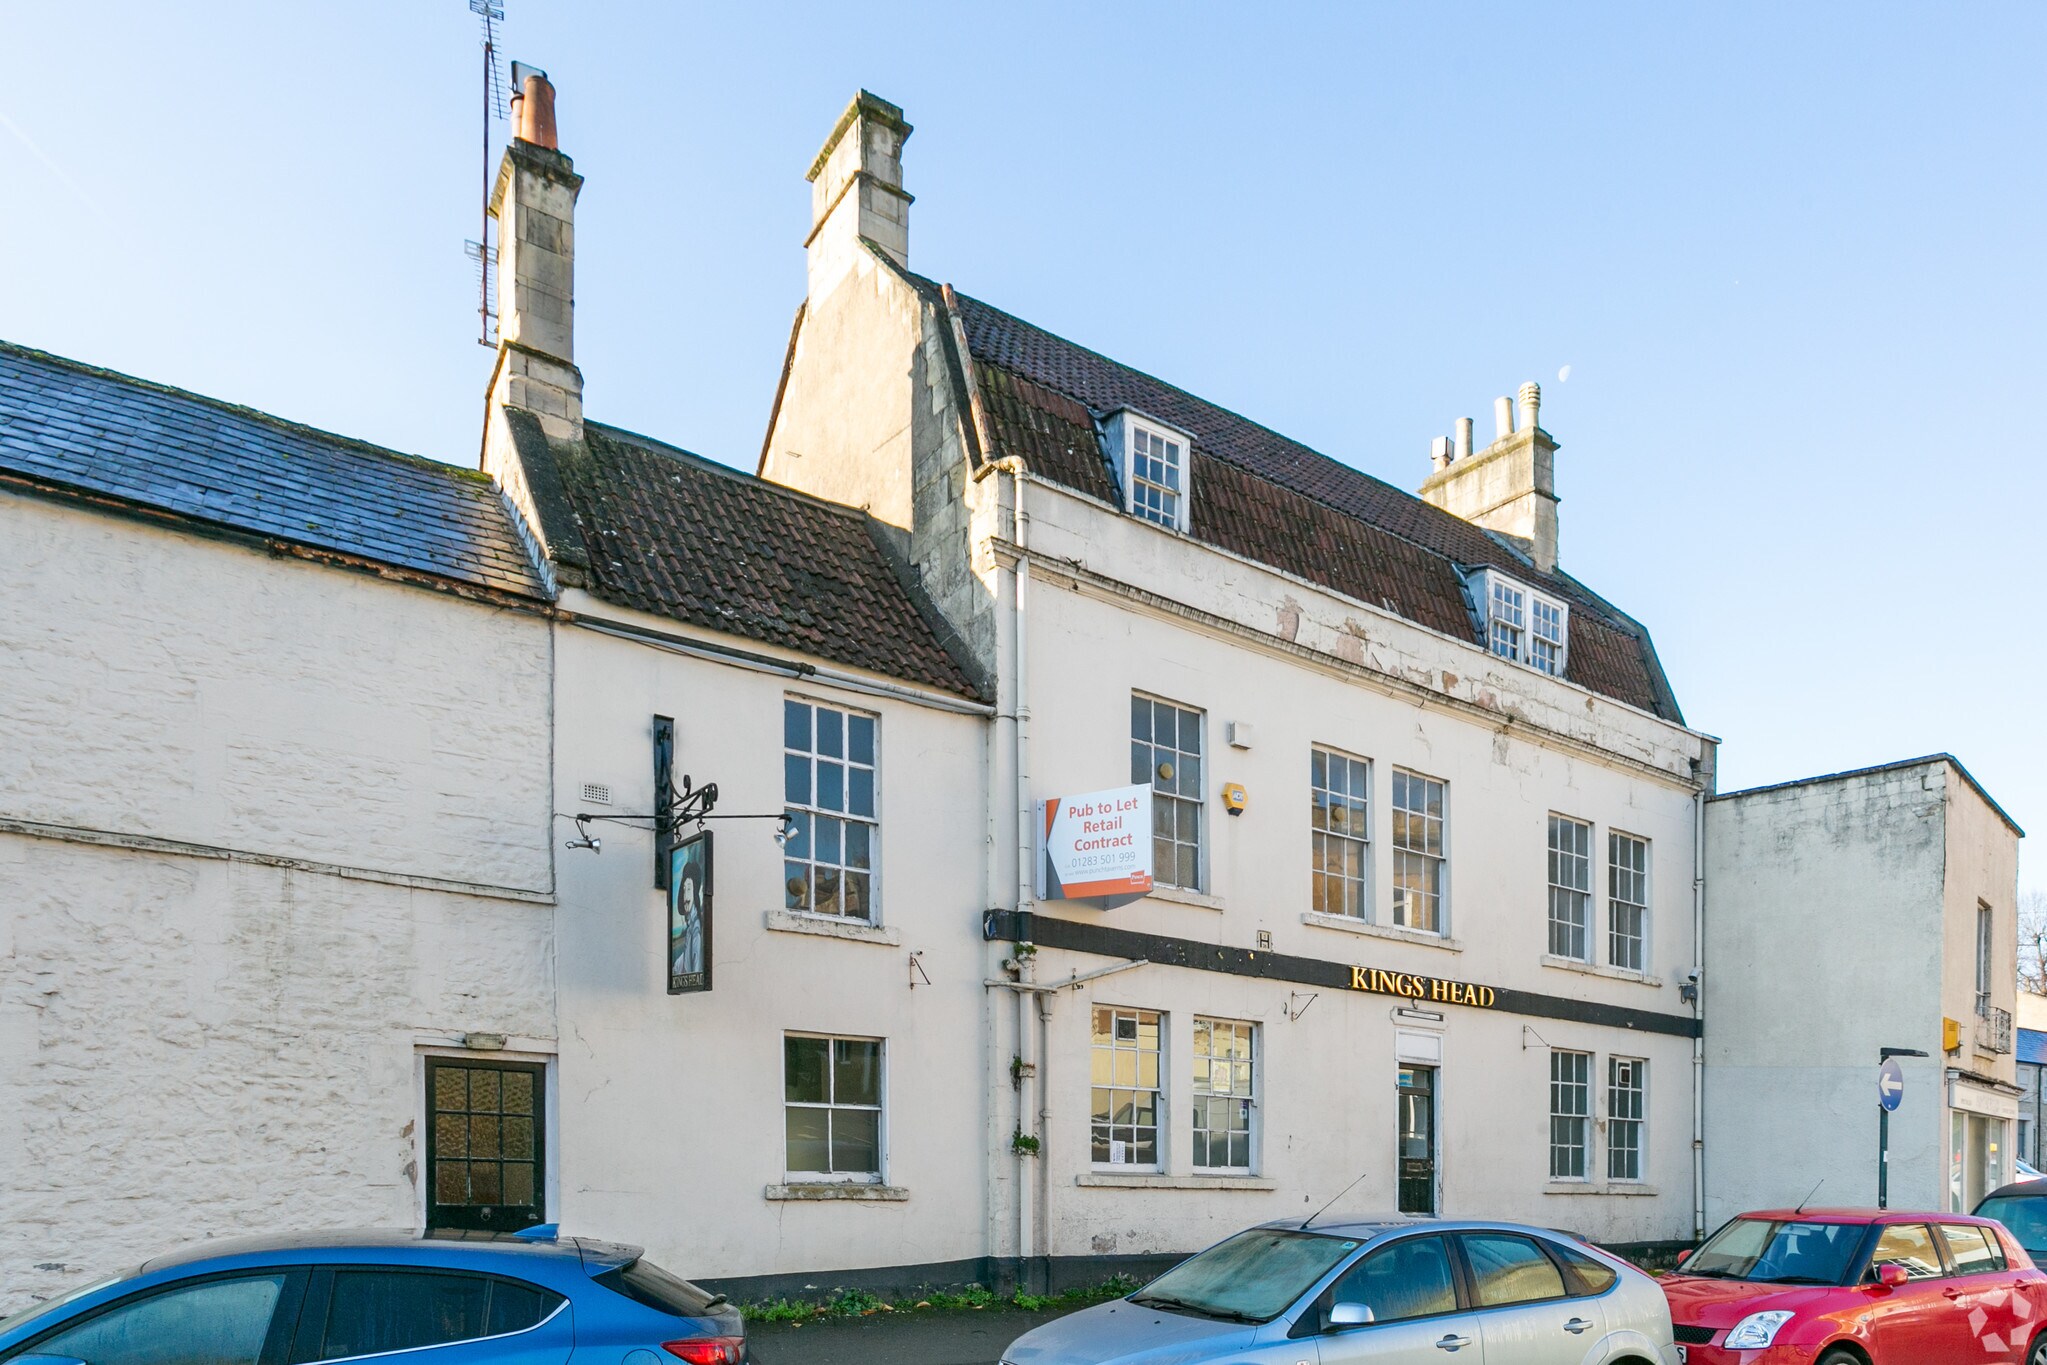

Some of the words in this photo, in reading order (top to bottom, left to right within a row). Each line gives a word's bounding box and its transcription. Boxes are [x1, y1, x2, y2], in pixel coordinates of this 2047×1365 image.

[1069, 804, 1093, 818] Pub
[1098, 803, 1112, 814] to
[1117, 797, 1138, 811] Let
[1083, 816, 1122, 833] Retail
[1074, 834, 1133, 851] Contract
[1071, 856, 1098, 868] 01283
[1100, 854, 1115, 865] 501
[1119, 851, 1136, 862] 999
[672, 975, 688, 988] KINGS
[1351, 966, 1424, 998] KINGS
[1432, 979, 1494, 1007] HEAD
